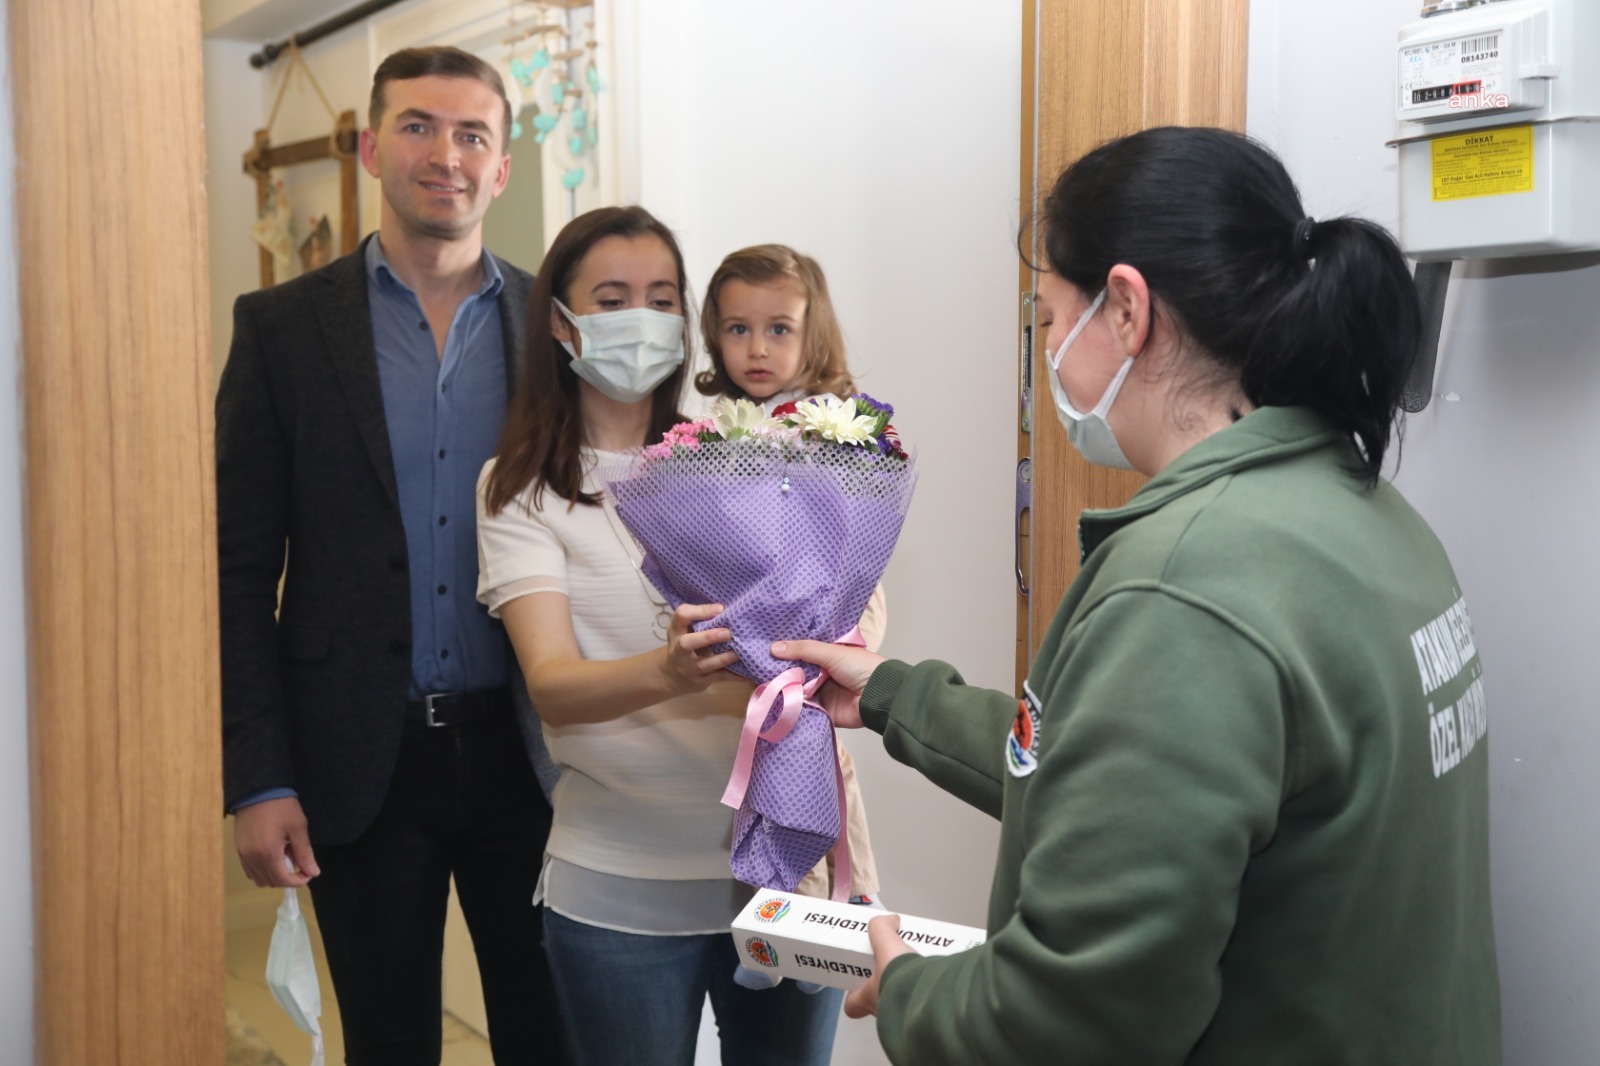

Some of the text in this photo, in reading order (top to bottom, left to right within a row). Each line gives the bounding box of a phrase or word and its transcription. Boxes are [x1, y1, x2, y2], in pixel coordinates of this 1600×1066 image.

[1461, 51, 1498, 63] 08143740
[1465, 135, 1494, 145] DİKKAT
[1428, 701, 1461, 779] ÖZEL
[802, 912, 869, 933] LEDİYESİ
[794, 953, 872, 979] BELEDİYESİ
